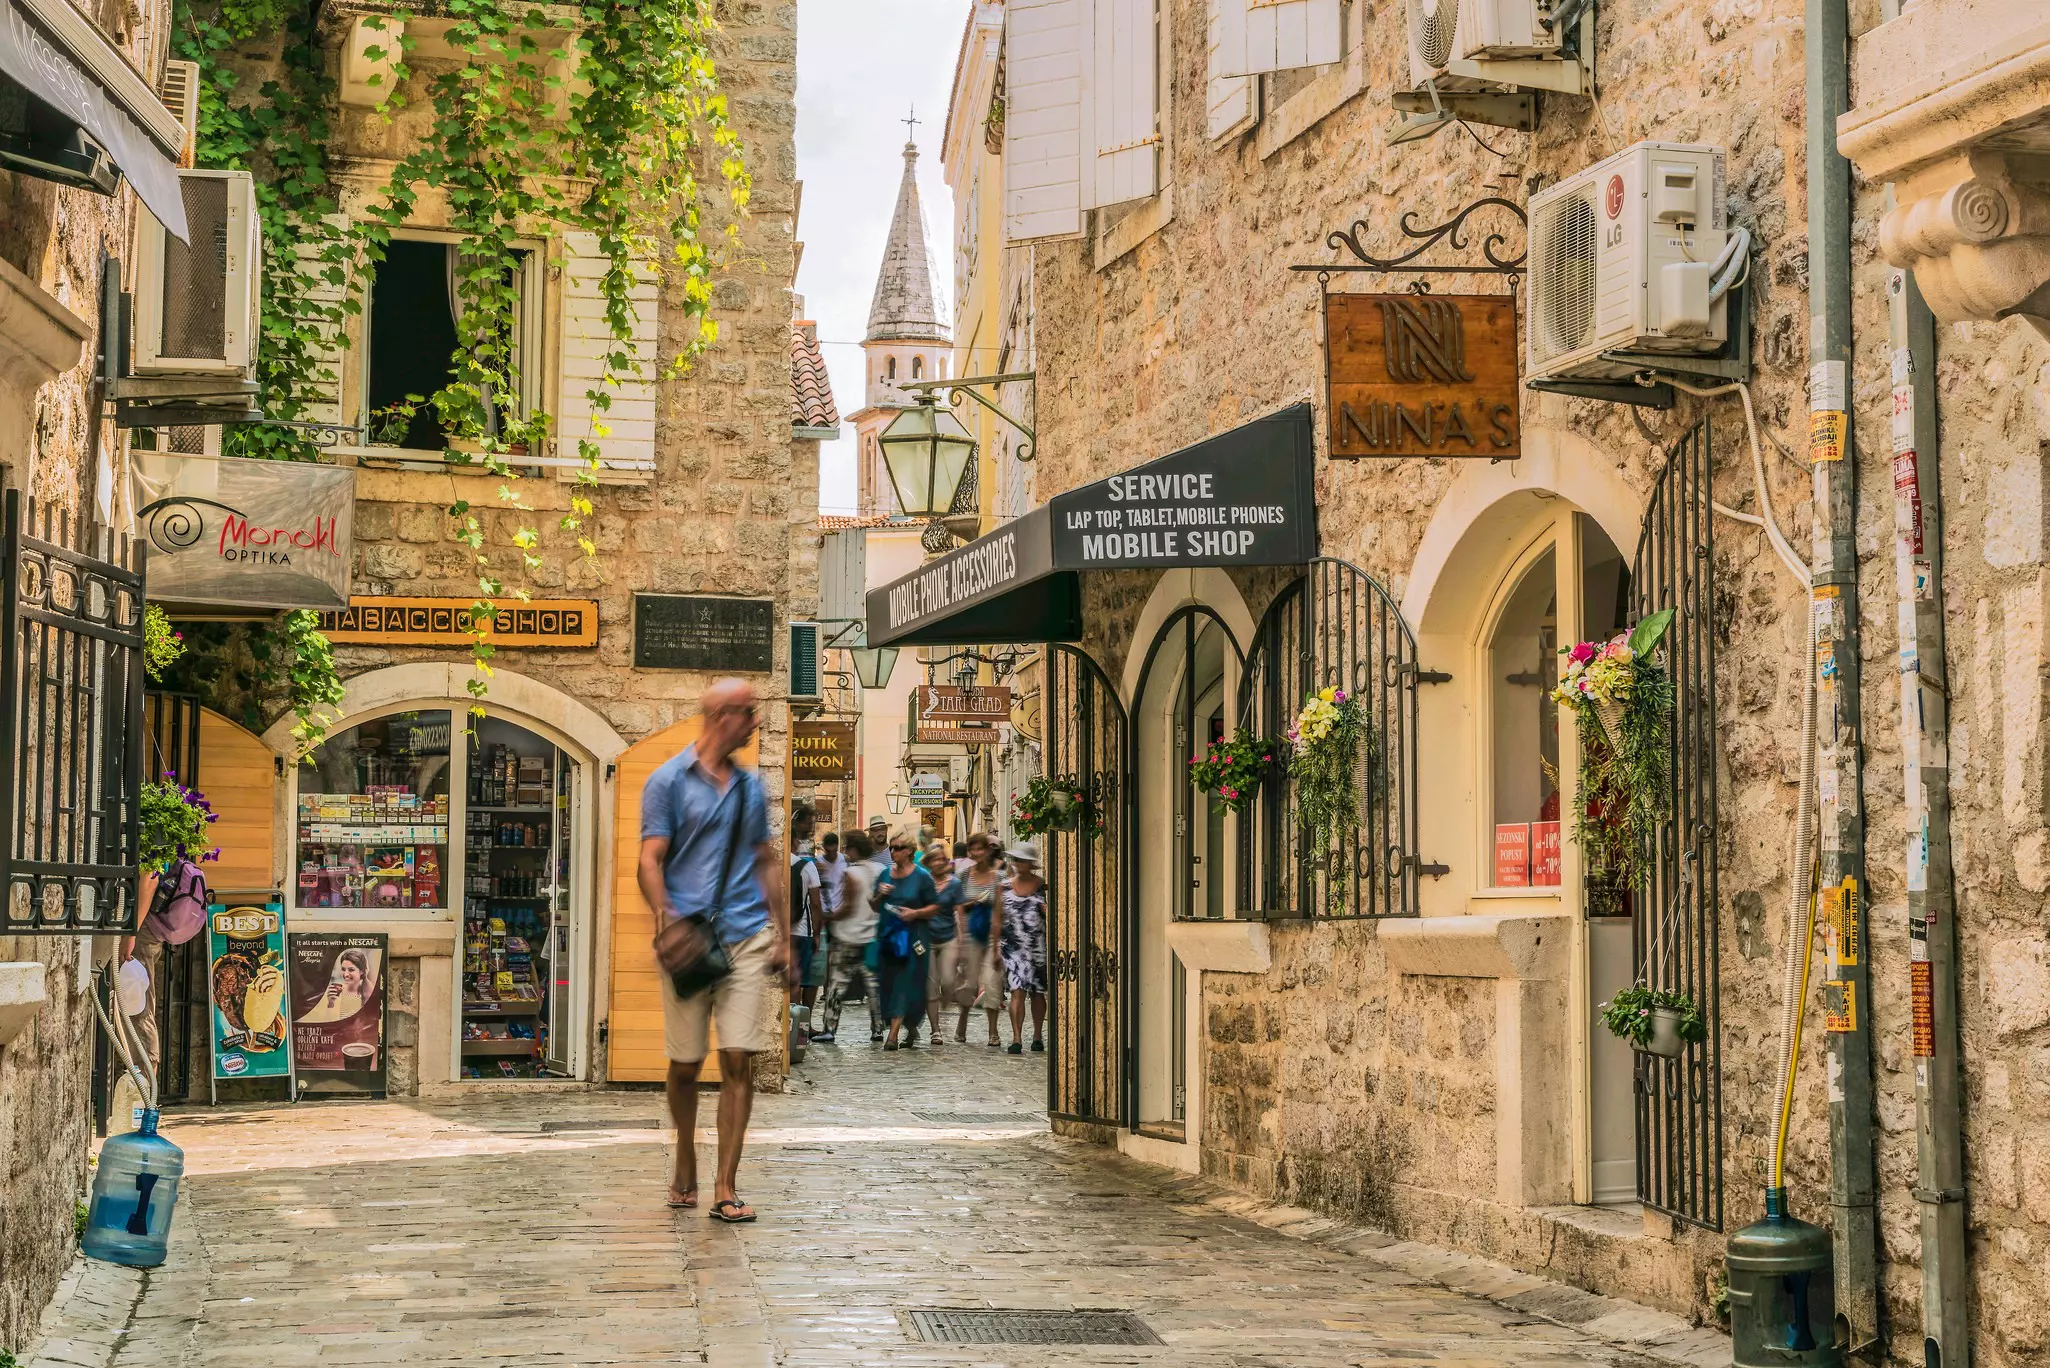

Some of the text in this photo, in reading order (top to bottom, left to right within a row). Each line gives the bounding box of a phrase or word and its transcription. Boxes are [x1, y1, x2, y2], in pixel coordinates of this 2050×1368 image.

[1607, 223, 1622, 248] LG
[1340, 398, 1513, 448] NINA'S
[1108, 474, 1214, 501] SERVICE
[1067, 511, 1092, 530] LAP
[1095, 510, 1123, 530] TOP,
[1231, 506, 1285, 524] PHONES
[219, 514, 340, 557] Monokl
[1082, 530, 1255, 560] MOBILE SHOP
[225, 549, 291, 565] OPTIKA
[889, 532, 1016, 630] MOBILE PHONE ACCESSORIES
[496, 611, 579, 633] SHOP
[970, 696, 1002, 712] GRAD
[792, 737, 838, 750] BUTIK
[922, 730, 998, 741] NATIONAL RESTAURANT
[793, 755, 844, 768] IRKON
[1500, 849, 1523, 861] POPUST
[217, 915, 276, 932] BEST
[229, 940, 265, 951] beyond
